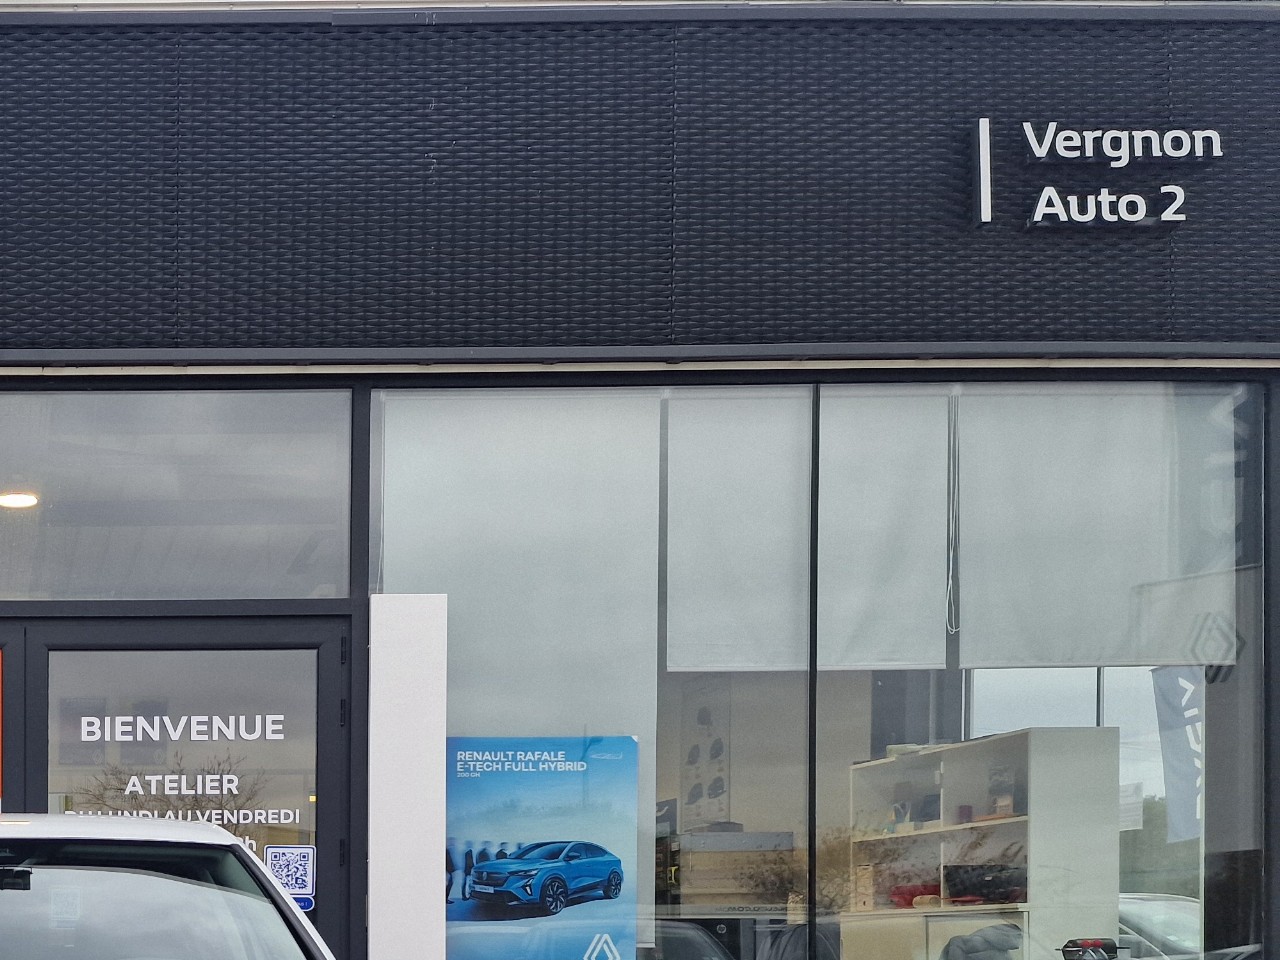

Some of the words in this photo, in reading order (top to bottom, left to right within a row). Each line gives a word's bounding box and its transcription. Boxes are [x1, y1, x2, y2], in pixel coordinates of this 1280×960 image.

[1022, 121, 1223, 168] Vergnon
[1033, 186, 1147, 222] Auto
[1160, 185, 1187, 221] 2
[80, 714, 285, 742] BIENVENUE
[456, 762, 502, 771] E-TECH
[504, 762, 537, 771] FULL
[539, 761, 587, 771] HYBRID
[457, 751, 514, 761] RENAULT
[517, 751, 566, 761] RAFALE
[124, 774, 239, 795] ATELIER
[195, 809, 299, 824] VENDREDI
